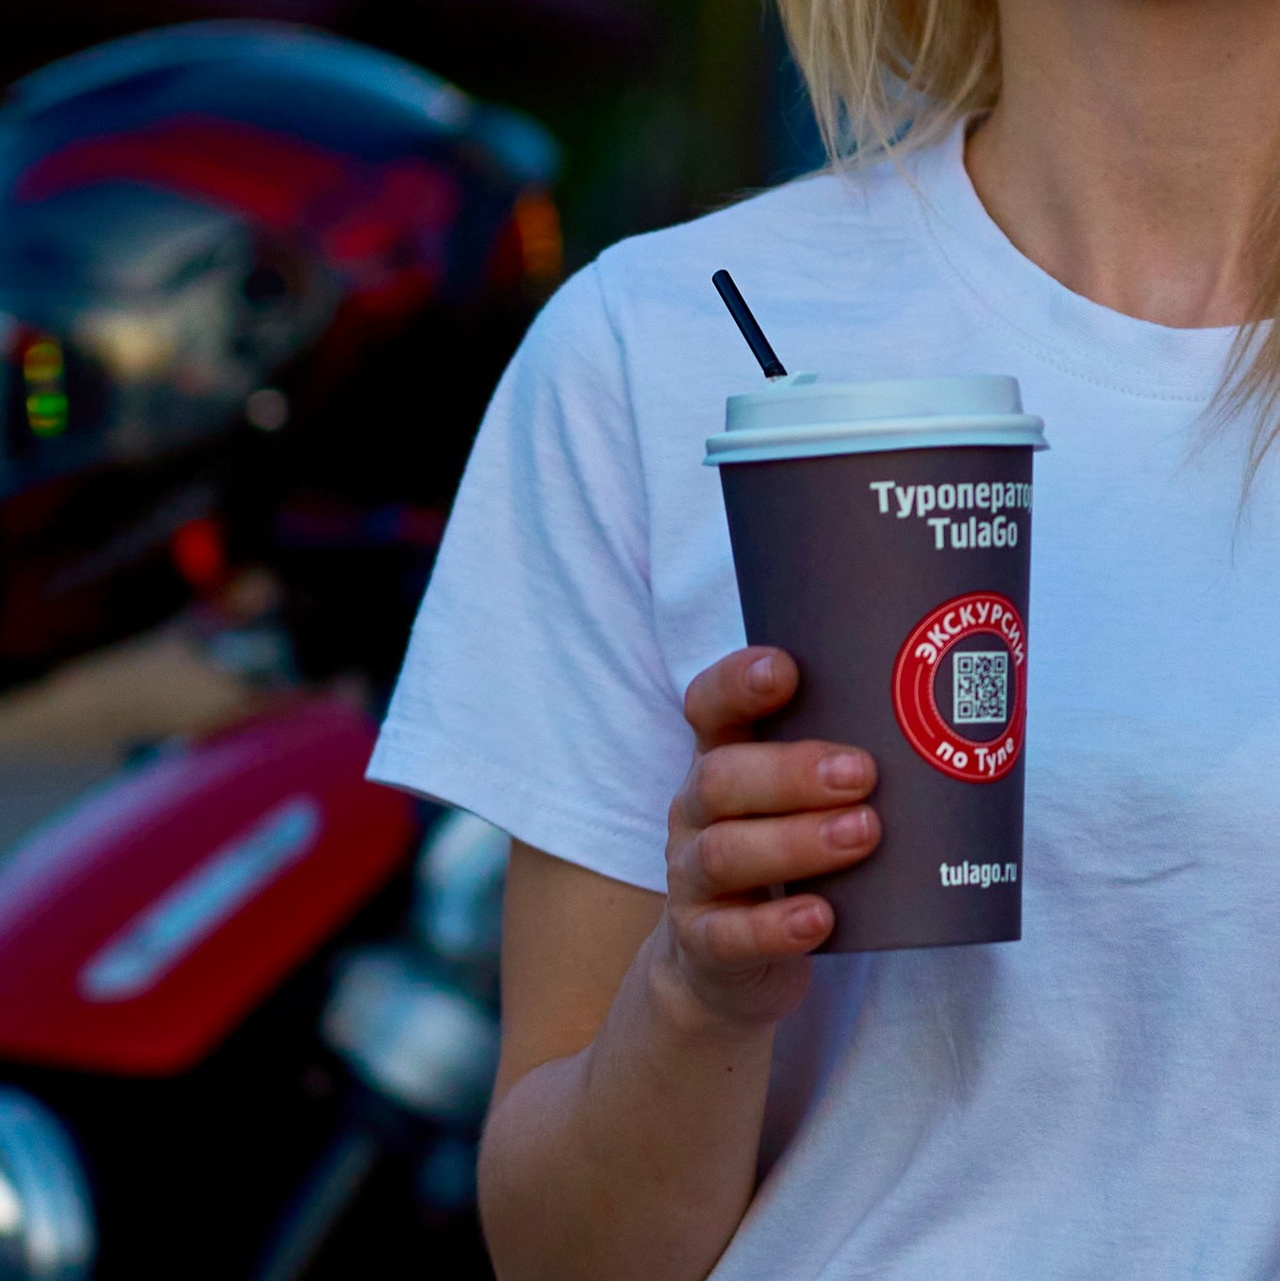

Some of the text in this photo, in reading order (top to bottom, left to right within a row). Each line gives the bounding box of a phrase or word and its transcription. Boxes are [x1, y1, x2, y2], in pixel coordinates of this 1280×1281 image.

[869, 480, 1032, 518] Туроперато
[927, 515, 1018, 550] TulaGo
[914, 601, 1025, 666] ЭКСКУРСИИ
[935, 740, 969, 769] по
[939, 860, 1018, 889] tulago.ru
